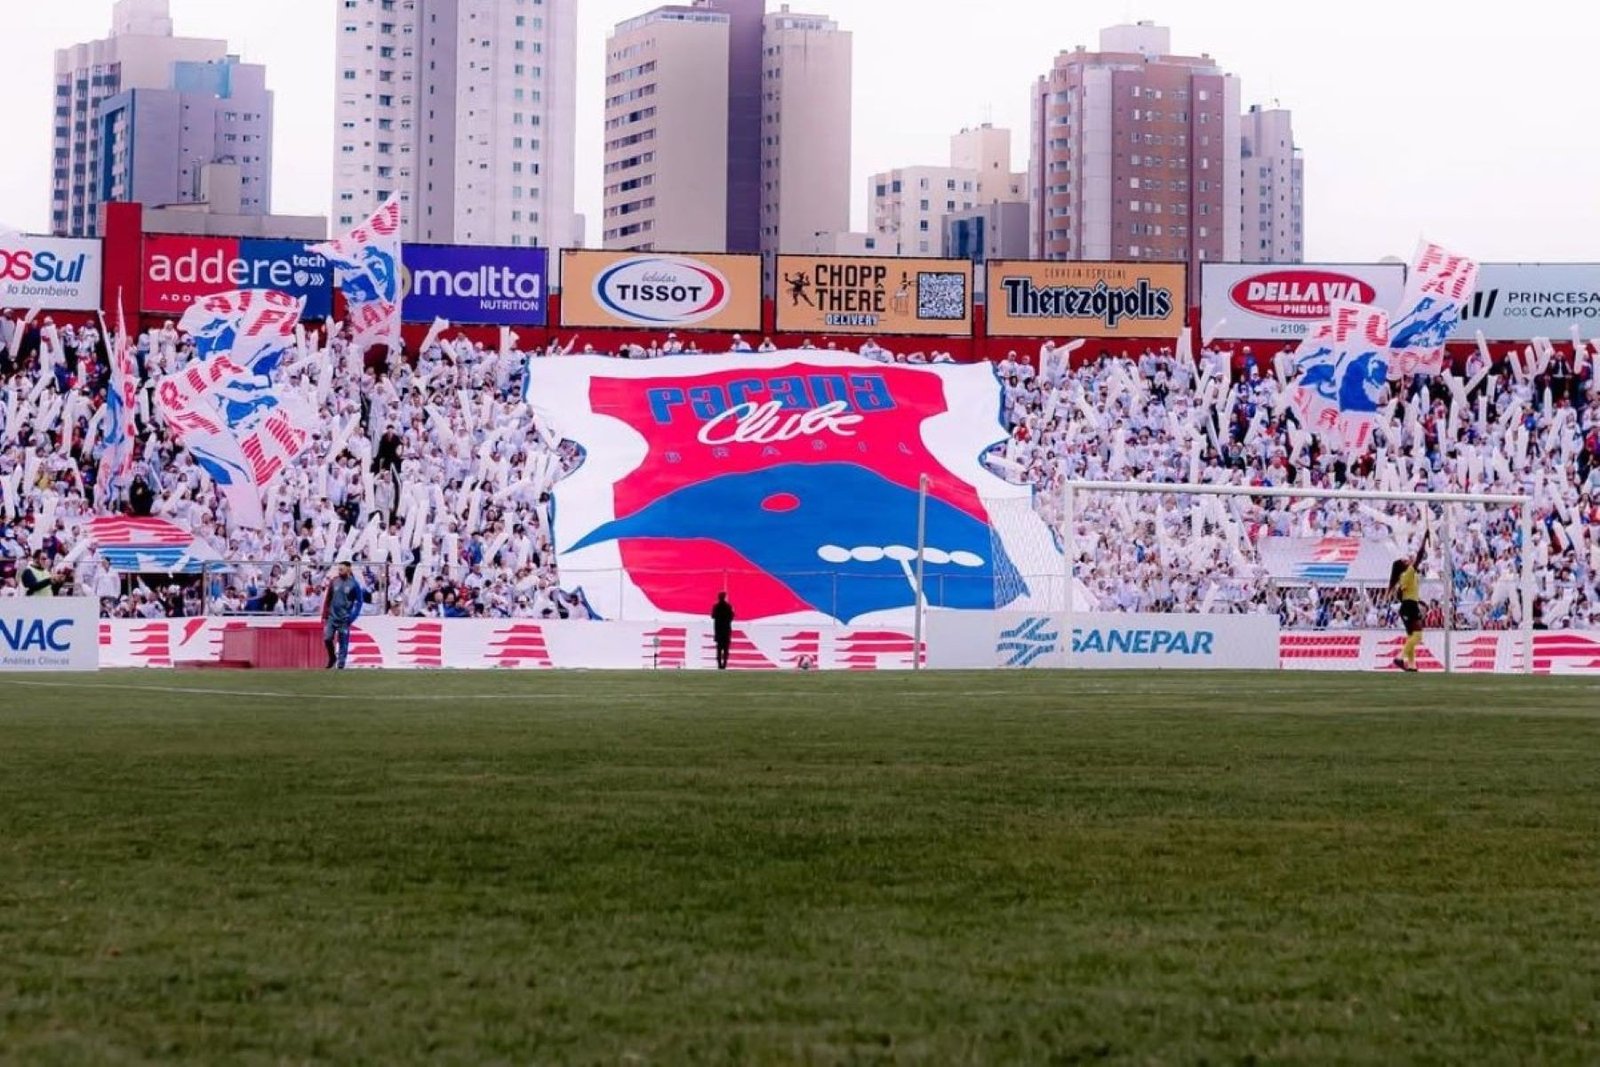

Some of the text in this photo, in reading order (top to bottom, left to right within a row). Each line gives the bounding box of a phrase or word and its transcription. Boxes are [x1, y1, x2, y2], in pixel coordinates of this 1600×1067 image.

[149, 248, 326, 286] addere tech
[815, 264, 887, 288] CHOPP
[21, 285, 79, 296] bombeiro
[414, 266, 540, 298] maltta
[616, 285, 702, 302] TISSOT
[1002, 277, 1172, 327] Therezópolis
[1508, 292, 1600, 304] PRINCESA
[480, 299, 539, 311] NUTRITION
[1503, 307, 1529, 317] DOS
[826, 314, 880, 326] DELIVERY
[697, 400, 864, 445] Clube
[0, 618, 74, 652] NAC
